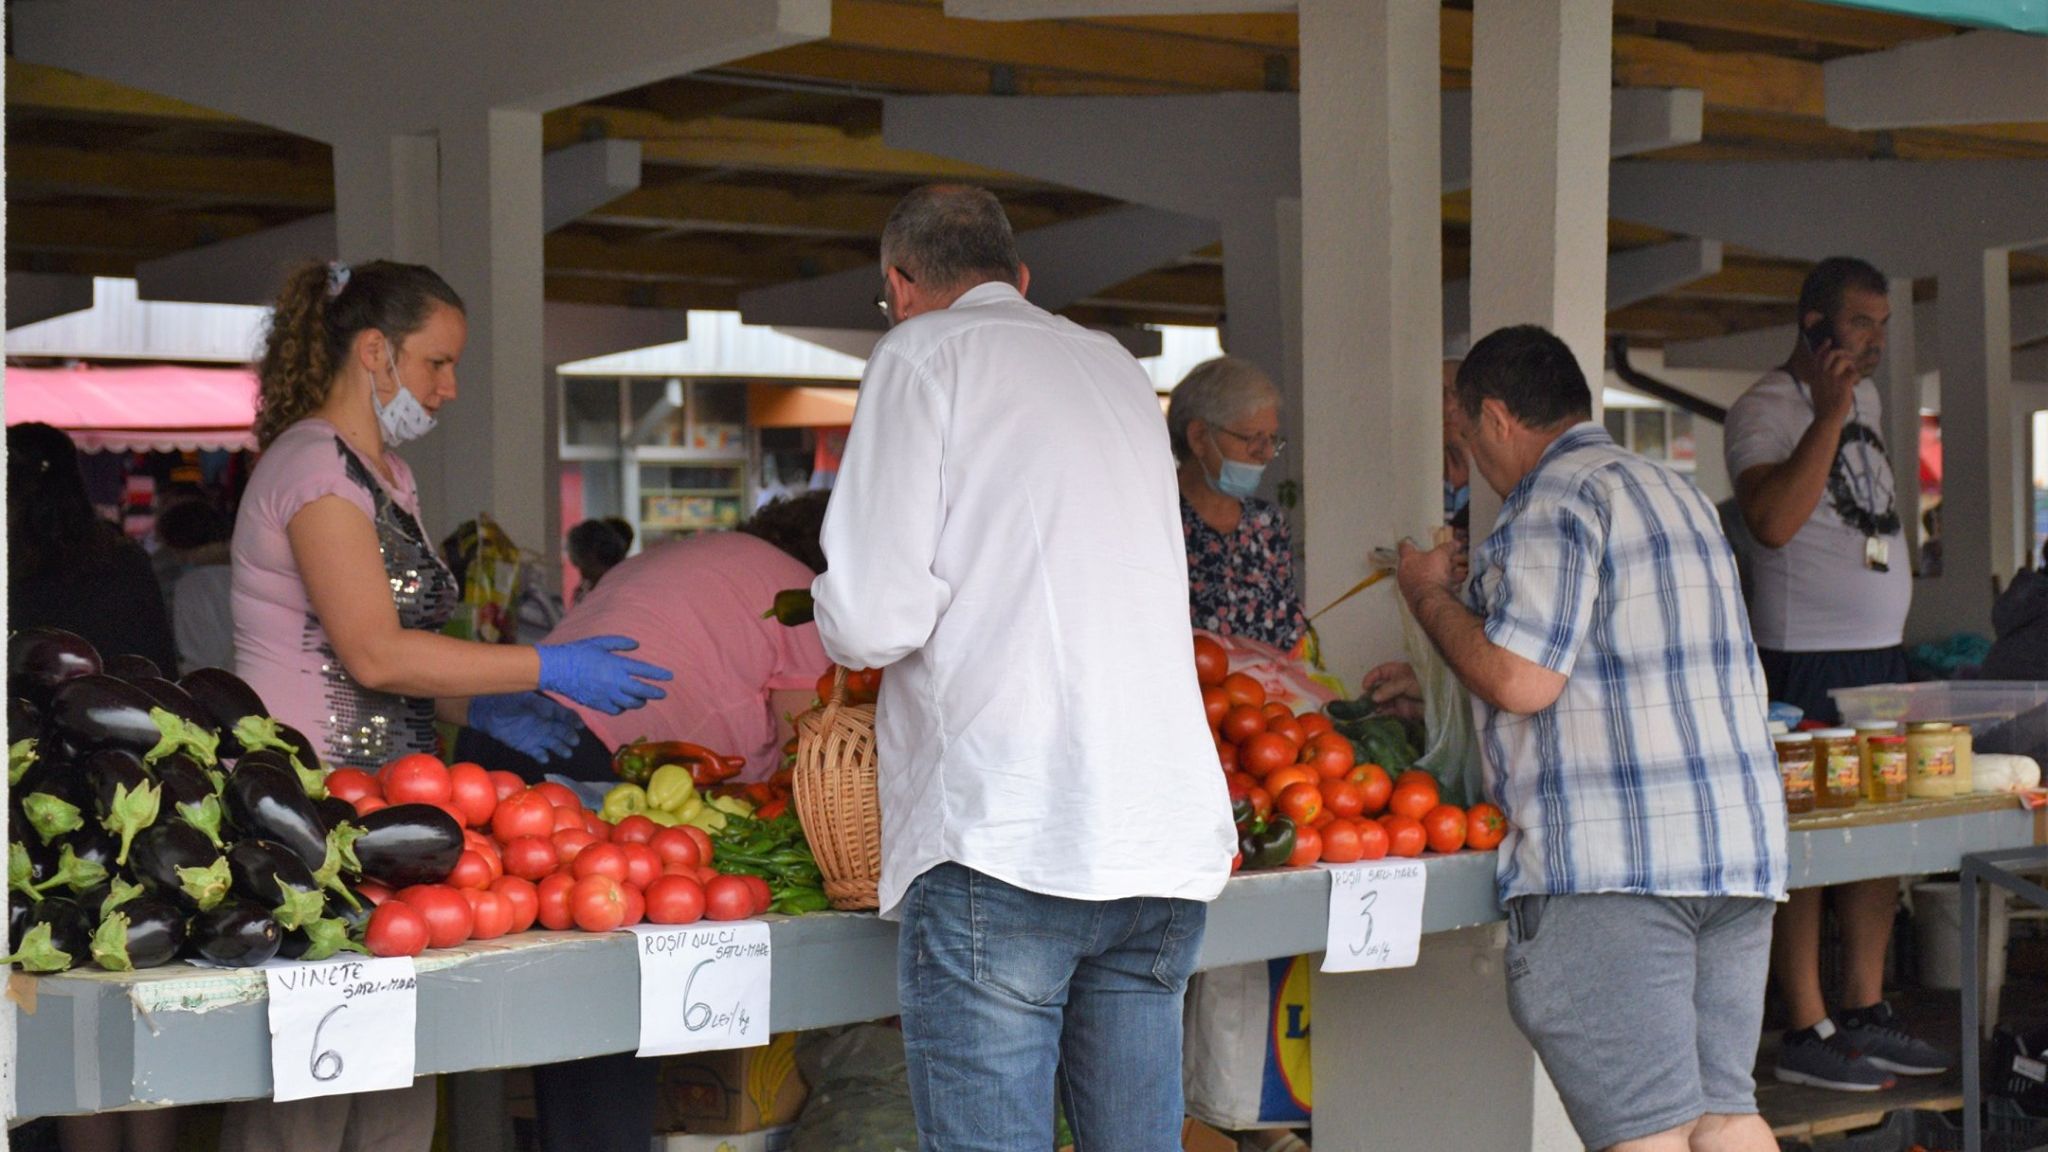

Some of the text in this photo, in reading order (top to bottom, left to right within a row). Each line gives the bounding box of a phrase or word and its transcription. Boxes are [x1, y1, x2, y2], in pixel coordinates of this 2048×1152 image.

[1348, 890, 1378, 957] 3
[682, 958, 716, 1032] 6
[309, 1003, 348, 1082] 6
